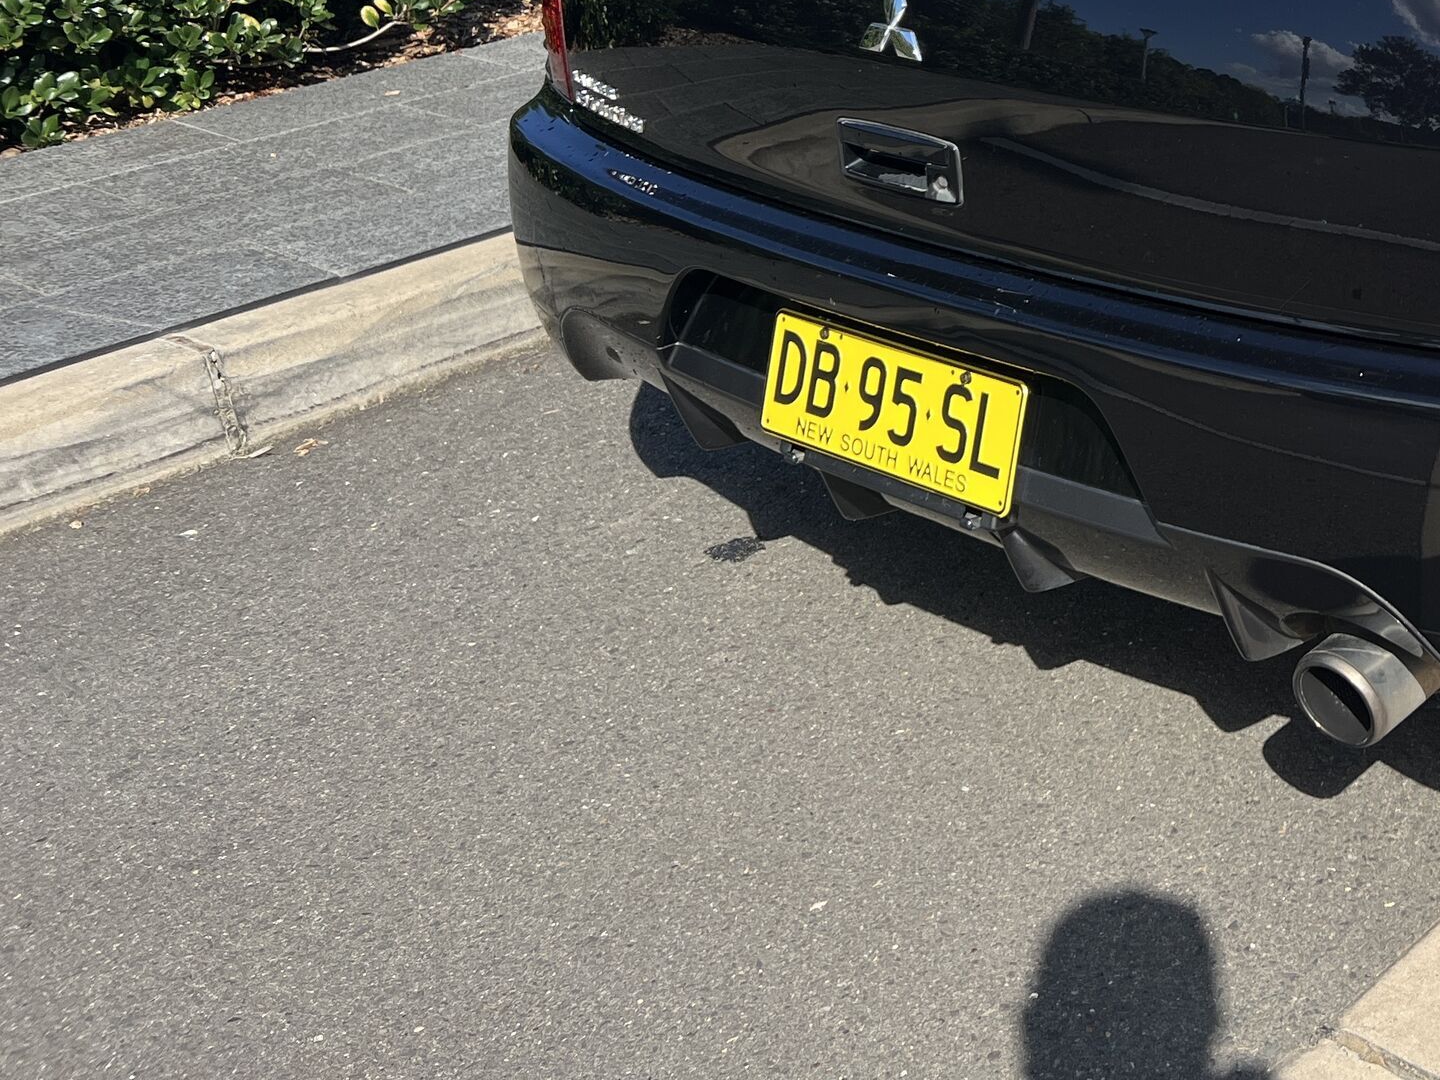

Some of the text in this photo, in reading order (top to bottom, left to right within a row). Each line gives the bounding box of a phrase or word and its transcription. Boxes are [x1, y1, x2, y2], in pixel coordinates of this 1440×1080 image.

[795, 416, 968, 493] NEW SOUTH WALES
